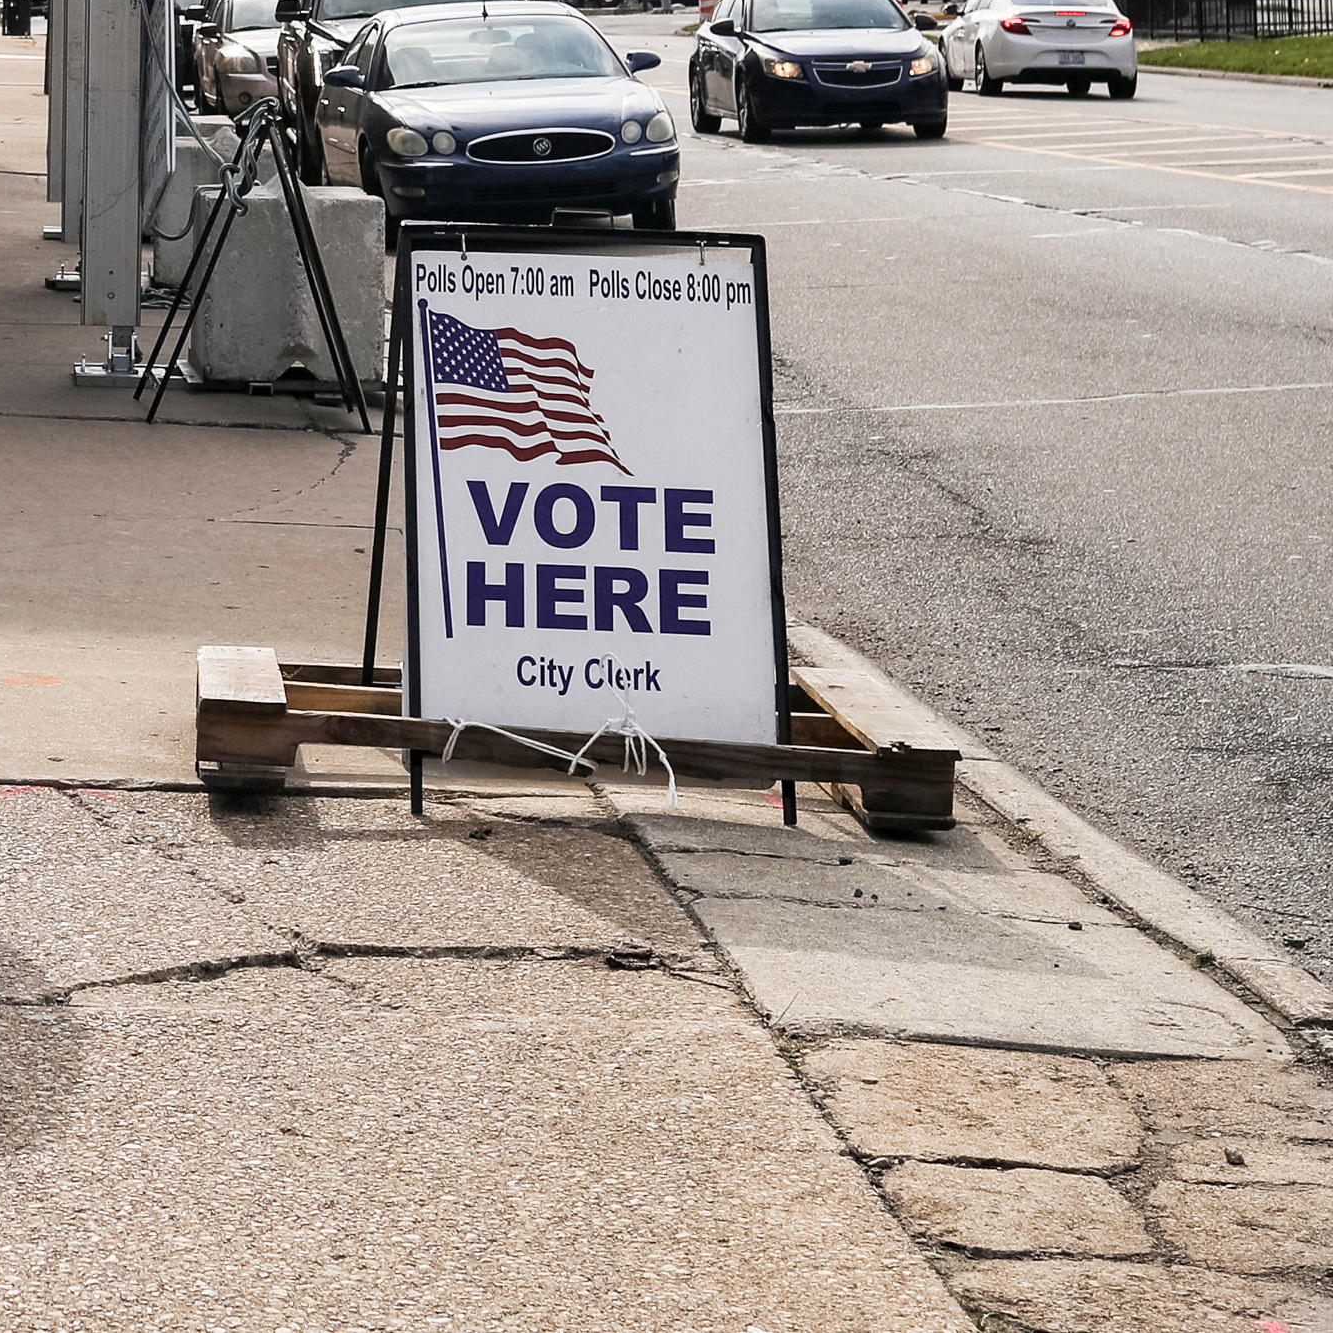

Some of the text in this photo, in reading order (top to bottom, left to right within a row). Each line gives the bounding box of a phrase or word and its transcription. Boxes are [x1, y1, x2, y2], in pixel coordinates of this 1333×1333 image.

[416, 263, 752, 311] Polls Open 7:00 am Polls Close 8:00 pm
[465, 480, 716, 555] VOTE
[466, 560, 712, 636] HERE
[516, 655, 662, 696] City Clerk
